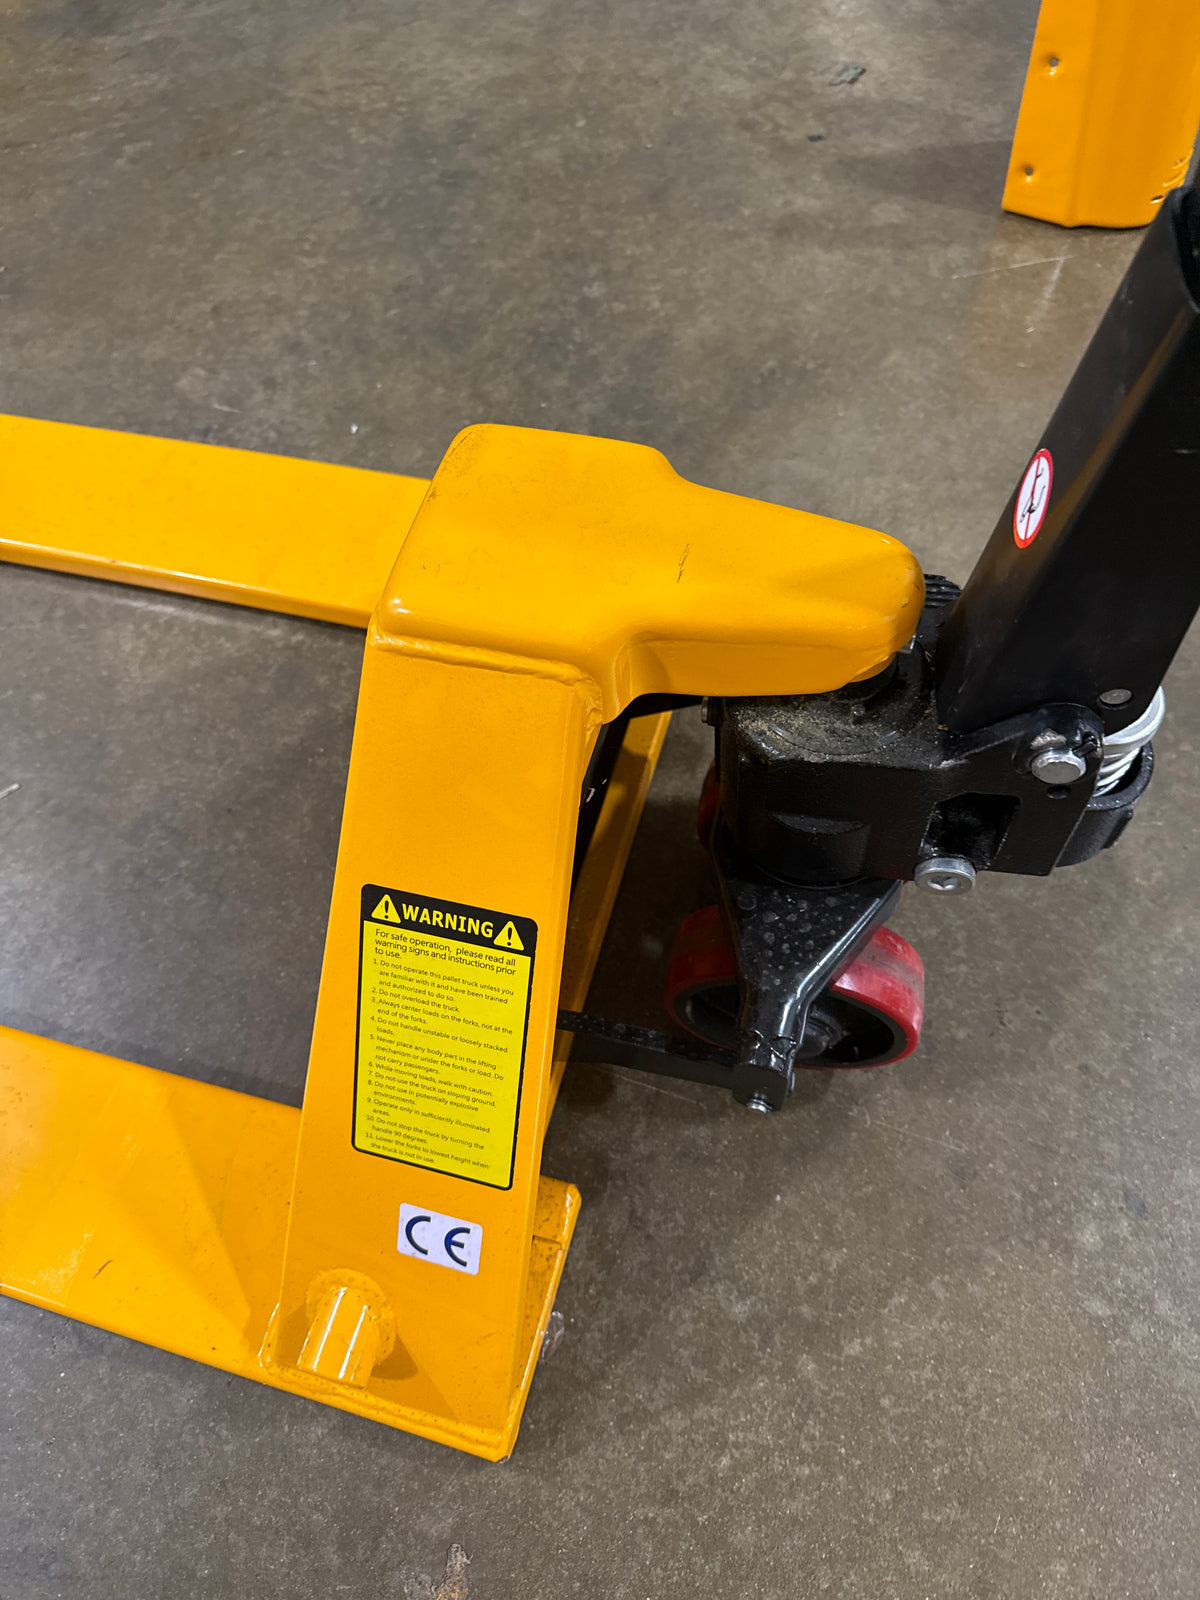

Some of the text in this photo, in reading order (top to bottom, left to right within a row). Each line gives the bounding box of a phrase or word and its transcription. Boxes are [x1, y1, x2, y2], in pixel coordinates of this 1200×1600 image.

[402, 903, 494, 938] WARNING
[374, 947, 405, 960] to use.
[375, 928, 515, 967] For safe operation, please read all
[375, 939, 516, 977] warning signs and instructions prior
[390, 971, 414, 983] familiar
[450, 985, 465, 994] have
[467, 989, 483, 999] been
[484, 994, 508, 1004] trained
[392, 983, 426, 995] authorized
[403, 966, 428, 977] operate
[429, 971, 441, 979] this
[442, 975, 460, 984] pallet
[462, 979, 478, 987] truck
[479, 984, 500, 993] unless
[501, 989, 514, 997] you
[377, 1008, 389, 1016] end
[398, 1012, 409, 1021] the
[401, 995, 429, 1006] overload
[378, 998, 400, 1010] Always
[401, 1004, 421, 1013] center
[422, 1008, 439, 1018] loads
[450, 1015, 461, 1023] the
[501, 1027, 512, 1035] the
[400, 1022, 422, 1033] handle
[422, 1029, 450, 1039] unstable
[459, 1036, 482, 1048] loosely
[483, 1043, 508, 1053] stacked
[375, 1045, 411, 1058] mechanism
[420, 1056, 439, 1065] under
[452, 1062, 467, 1072] forks
[375, 1054, 386, 1062] not
[387, 1057, 403, 1067] carry
[376, 1035, 395, 1045] Never
[396, 1041, 413, 1050] place
[414, 1045, 425, 1054] any
[426, 1048, 443, 1058] body
[444, 1052, 457, 1061] part
[477, 1060, 496, 1071] lifting
[375, 1063, 393, 1072] While
[394, 1068, 417, 1079] moving
[415, 1092, 448, 1106] potentially
[449, 1101, 478, 1113] explosive
[420, 1083, 436, 1092] truck
[447, 1090, 470, 1102] sloping
[405, 1215, 471, 1267] CE
